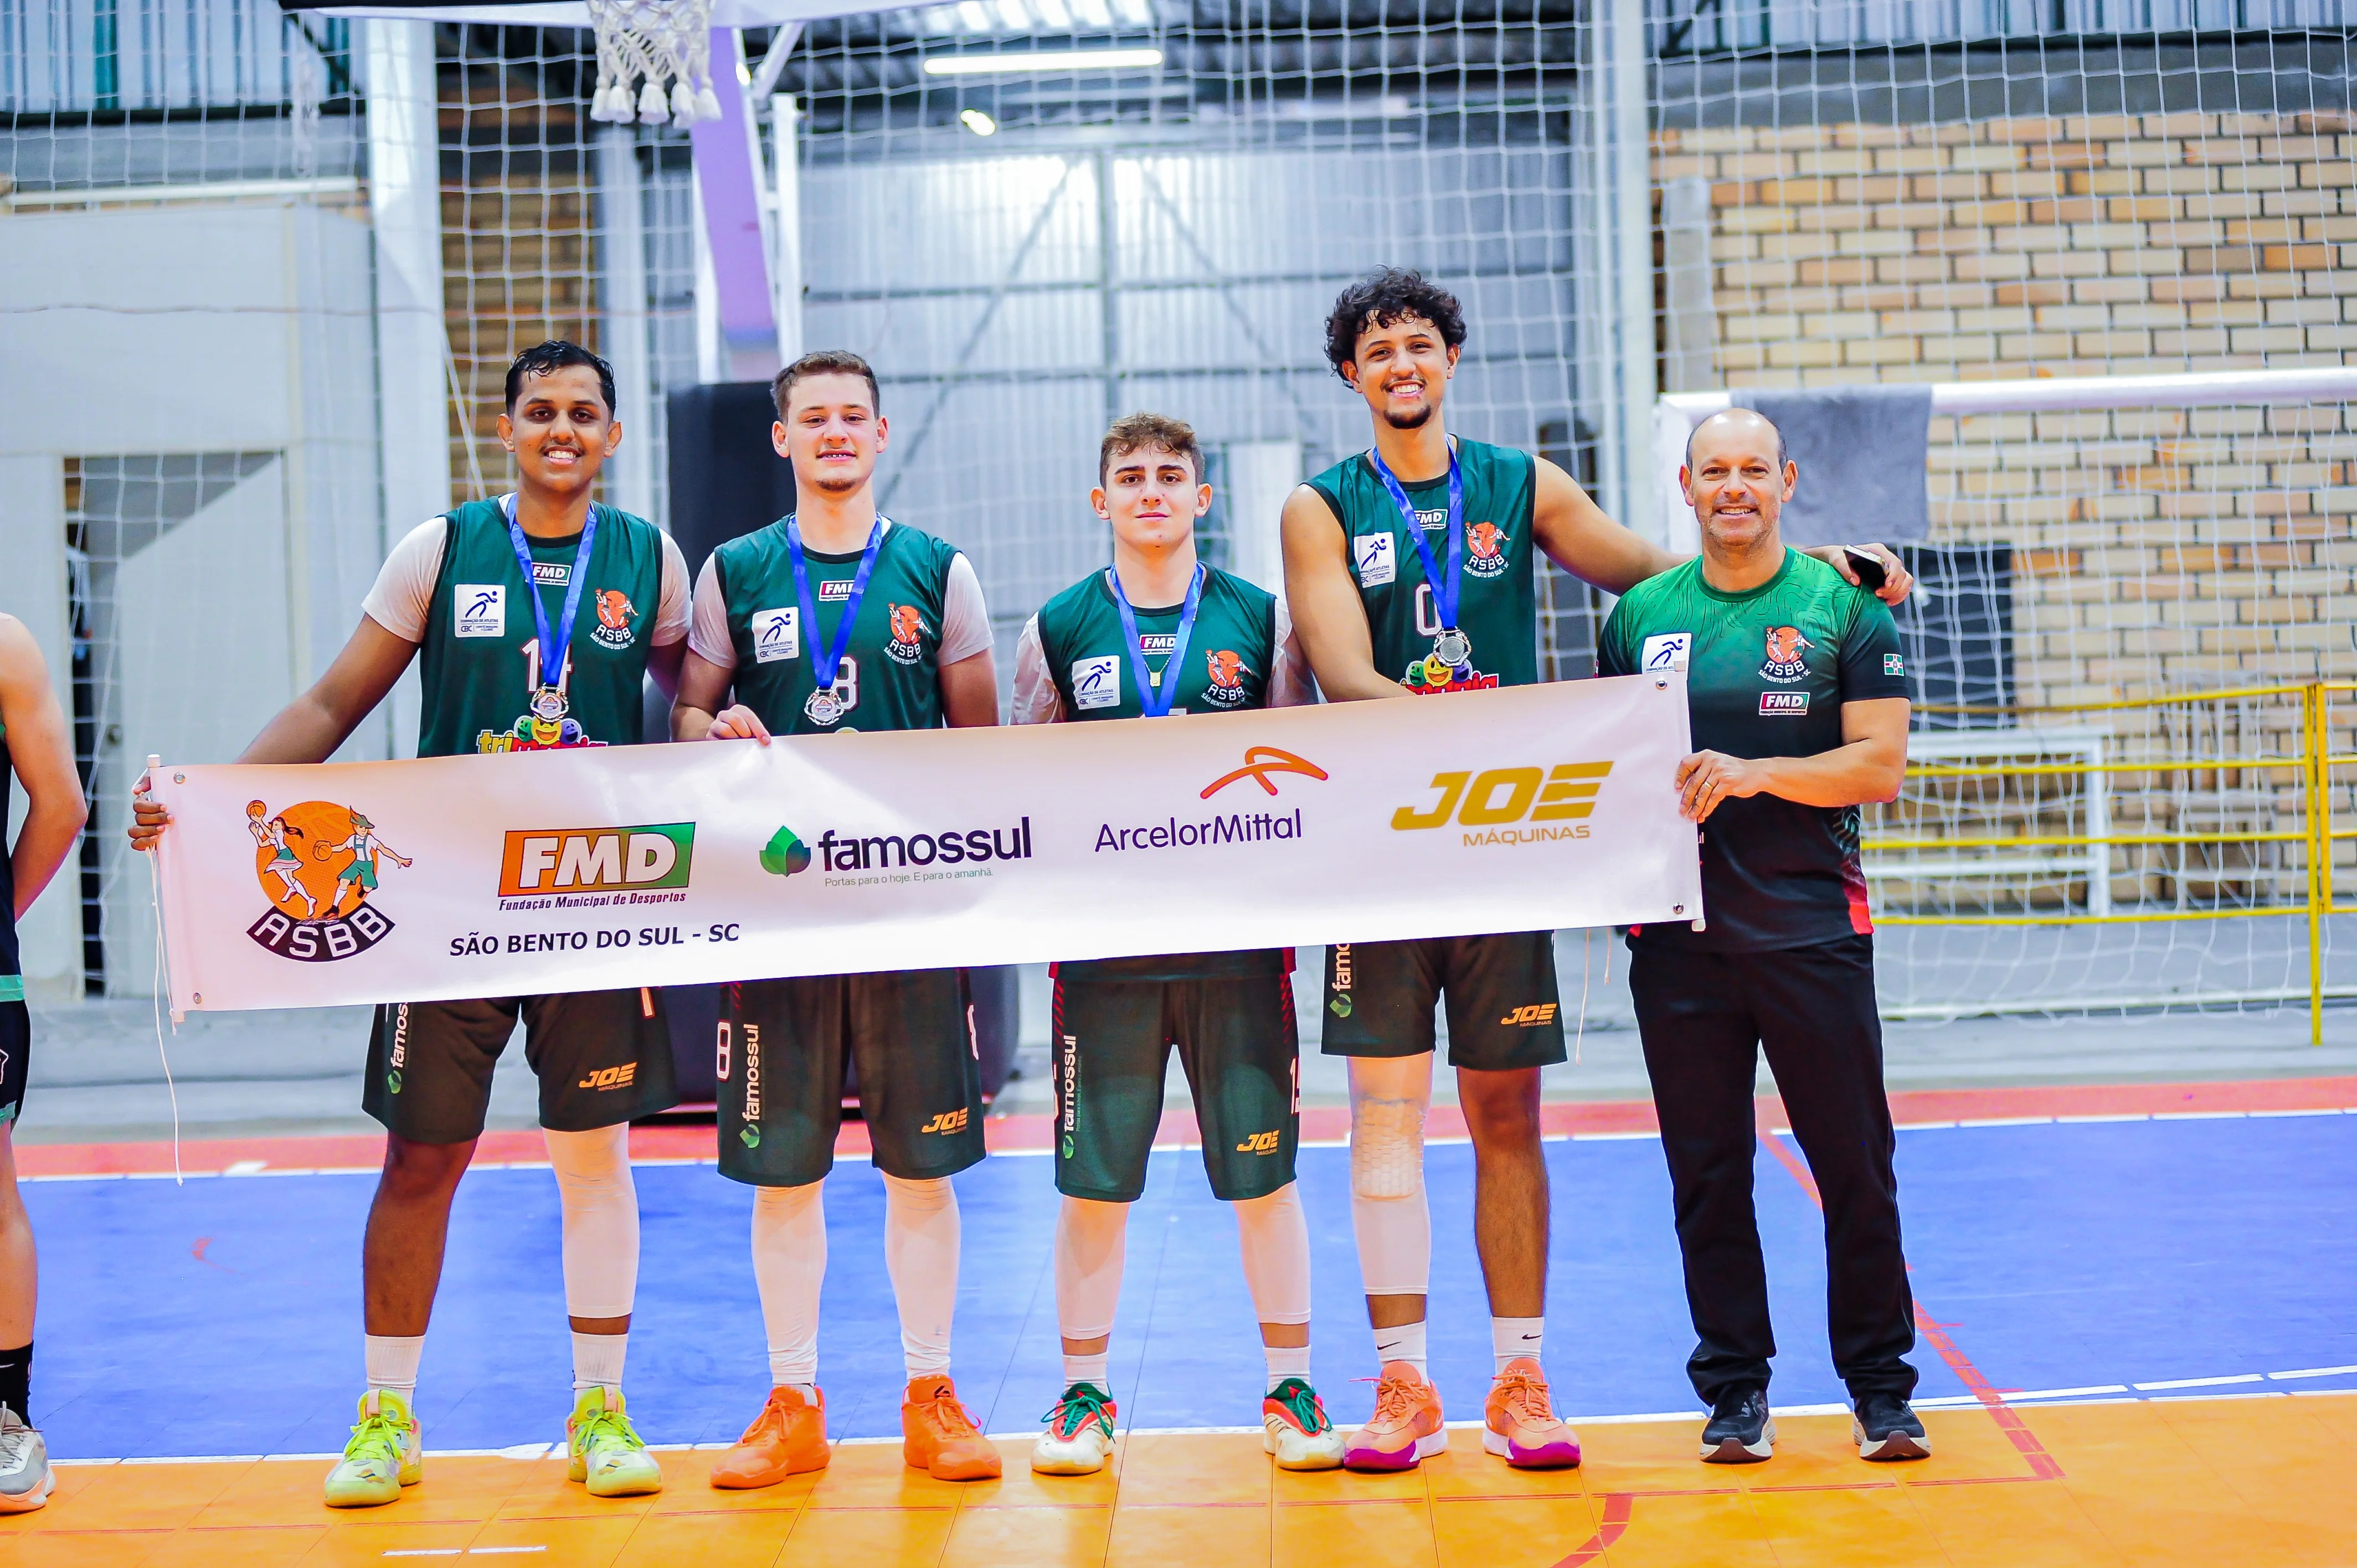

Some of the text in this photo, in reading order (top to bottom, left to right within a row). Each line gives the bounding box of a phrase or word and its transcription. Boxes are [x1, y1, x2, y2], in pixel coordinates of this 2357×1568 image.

[532, 566, 566, 578] FMD
[1469, 554, 1505, 570] ASBB
[595, 624, 631, 642] ASBB
[1144, 637, 1176, 648] FMD
[889, 638, 921, 657] ASBB
[1758, 669, 1768, 679] SÃO
[1766, 675, 1783, 684] BENTO
[1764, 660, 1805, 676] ASBB
[832, 656, 858, 711] 8
[1207, 684, 1245, 701] ASBB
[1201, 693, 1211, 703] SÃO
[1210, 699, 1226, 708] BENTO
[1766, 695, 1804, 708] FMD
[1390, 761, 1614, 831] JOE
[1094, 808, 1301, 852] ArcelorMittal
[1463, 825, 1590, 847] MÁQUINAS
[818, 816, 1032, 871] famossul
[518, 832, 678, 889] FMD
[825, 878, 856, 886] Portas
[858, 876, 879, 886] para
[889, 874, 912, 884] hoje.
[914, 872, 921, 881] E
[923, 873, 944, 882] para
[954, 868, 993, 878] amanhã.
[498, 893, 686, 911] Fundação Municipal de Desportos
[254, 907, 387, 958] ASBB
[450, 931, 499, 956] SÃO
[507, 931, 588, 954] BENTO
[595, 929, 631, 948] DO
[638, 926, 684, 946] SUL
[708, 924, 739, 942] SC
[1331, 943, 1351, 992] famo
[1501, 1003, 1557, 1025] JOE
[390, 1002, 408, 1068] famos
[717, 1022, 731, 1080] 8
[579, 1062, 637, 1088] JOE
[742, 1024, 760, 1121] famossul
[921, 1107, 967, 1133] JOE
[1236, 1129, 1280, 1152] JOE
